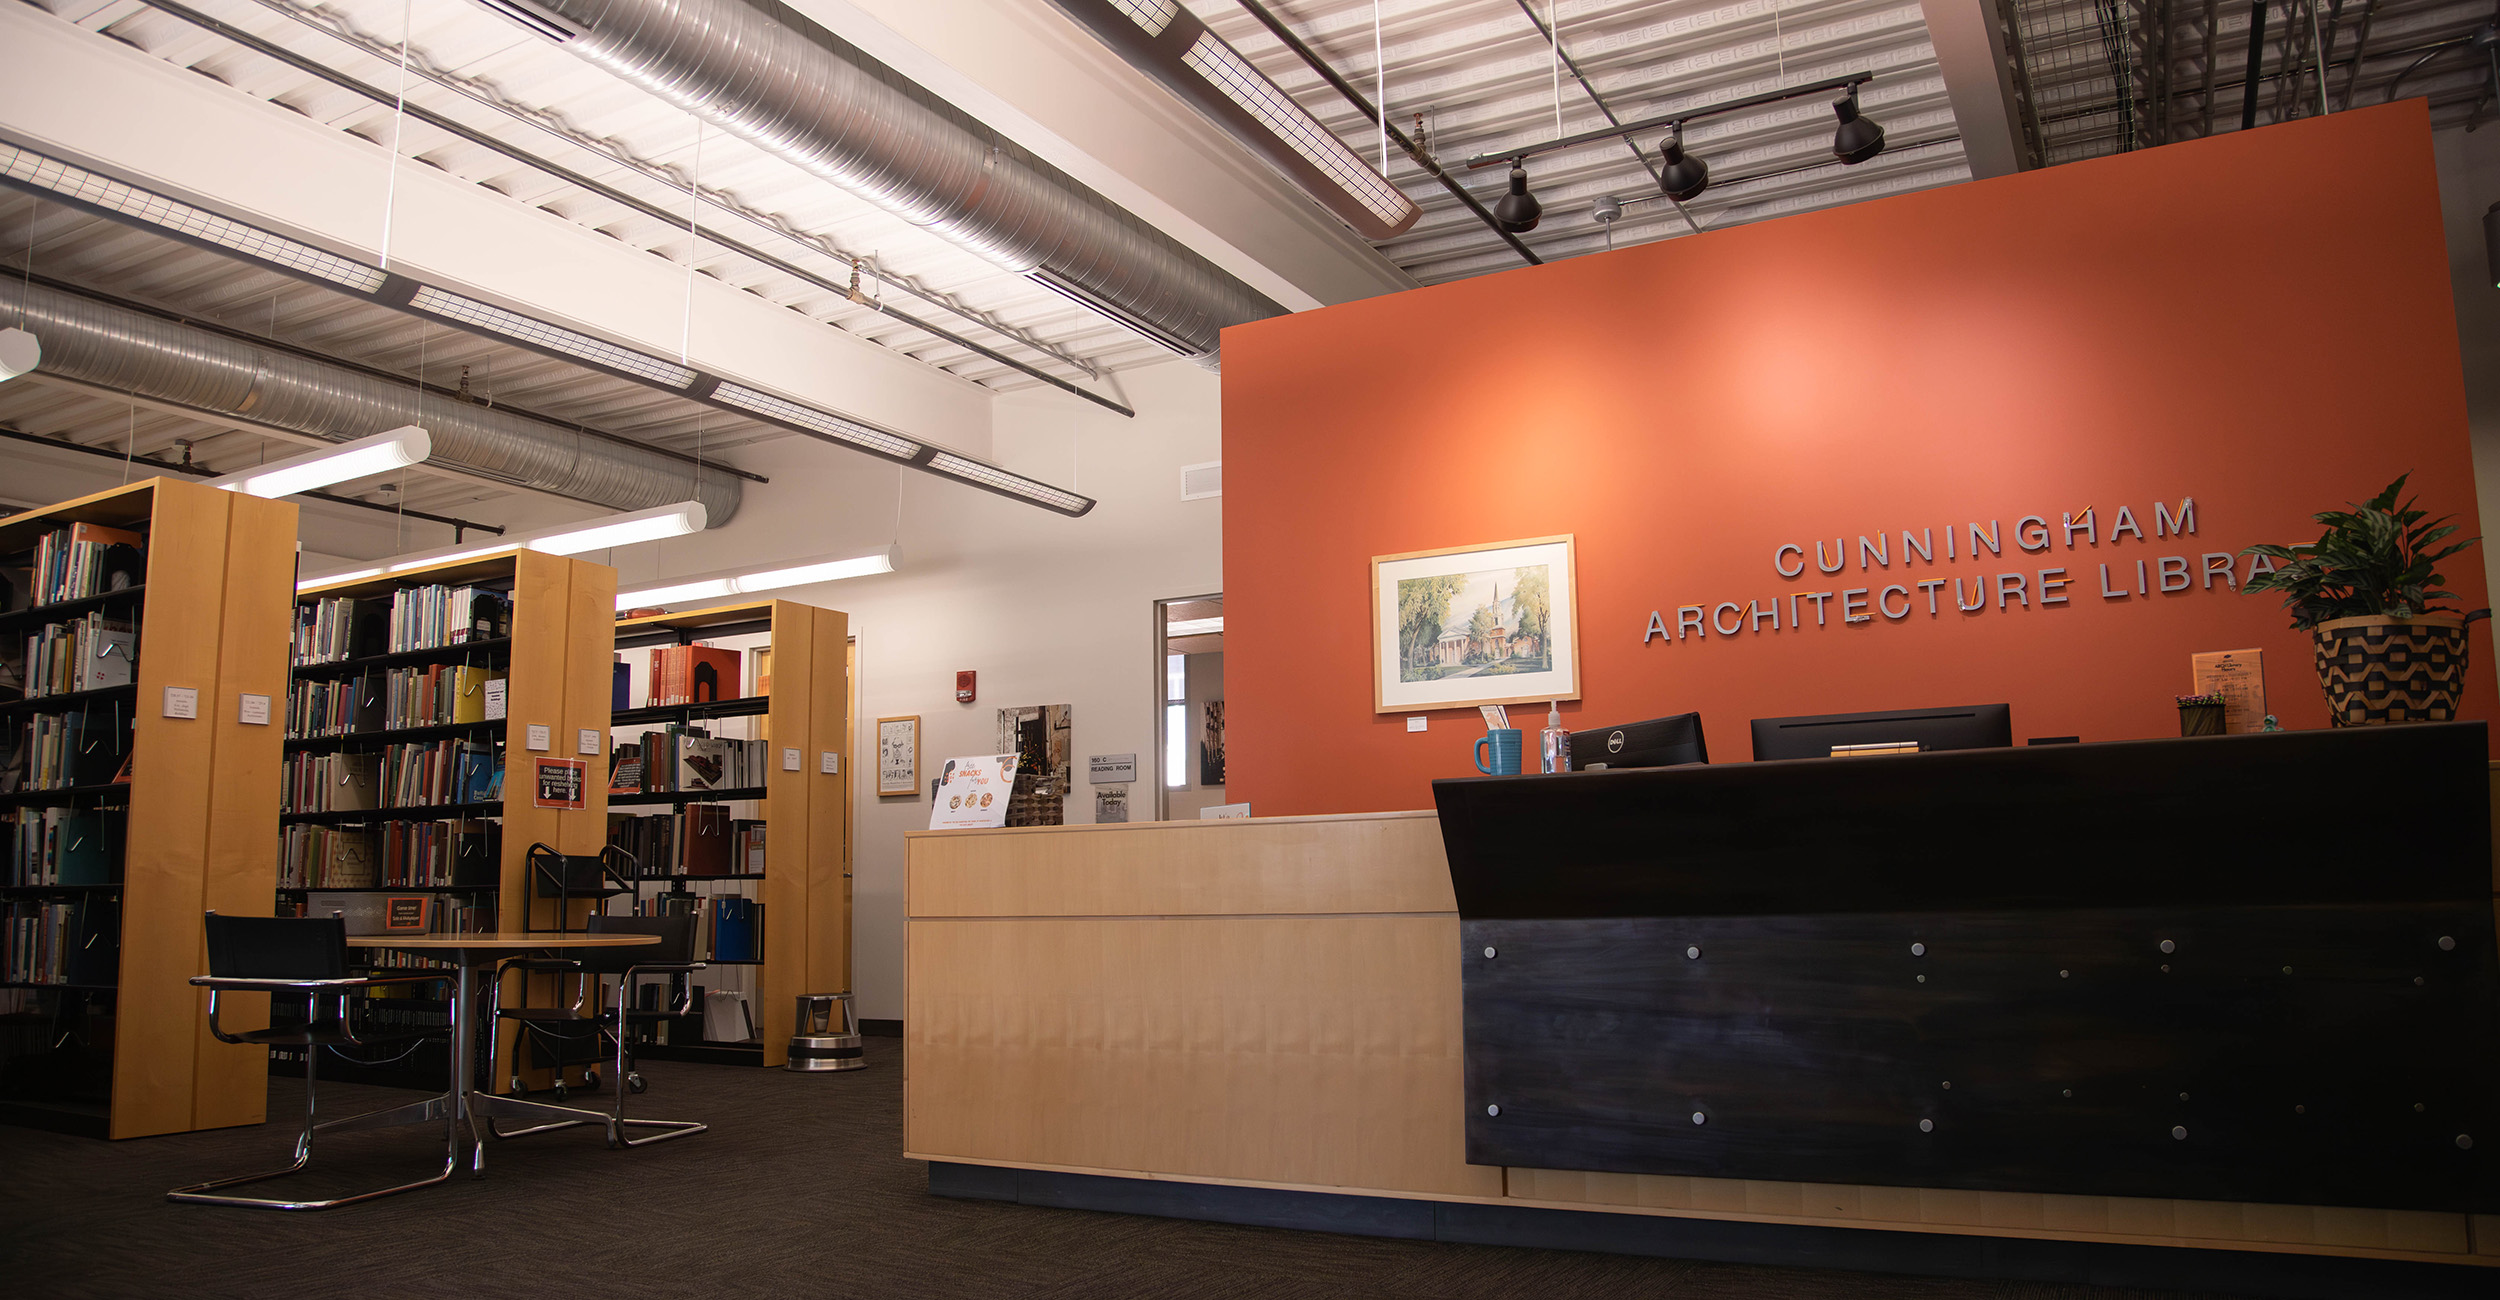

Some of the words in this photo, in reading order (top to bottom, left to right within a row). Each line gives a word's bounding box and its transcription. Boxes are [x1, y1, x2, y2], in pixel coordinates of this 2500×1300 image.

[1775, 497, 2195, 578] CUNNINGHAM
[1645, 567, 2069, 643] ARCHITECTURE
[2101, 542, 2320, 598] LIBRA
[959, 769, 982, 778] SNACKS
[1097, 791, 1126, 799] Available
[1102, 798, 1121, 807] Today
